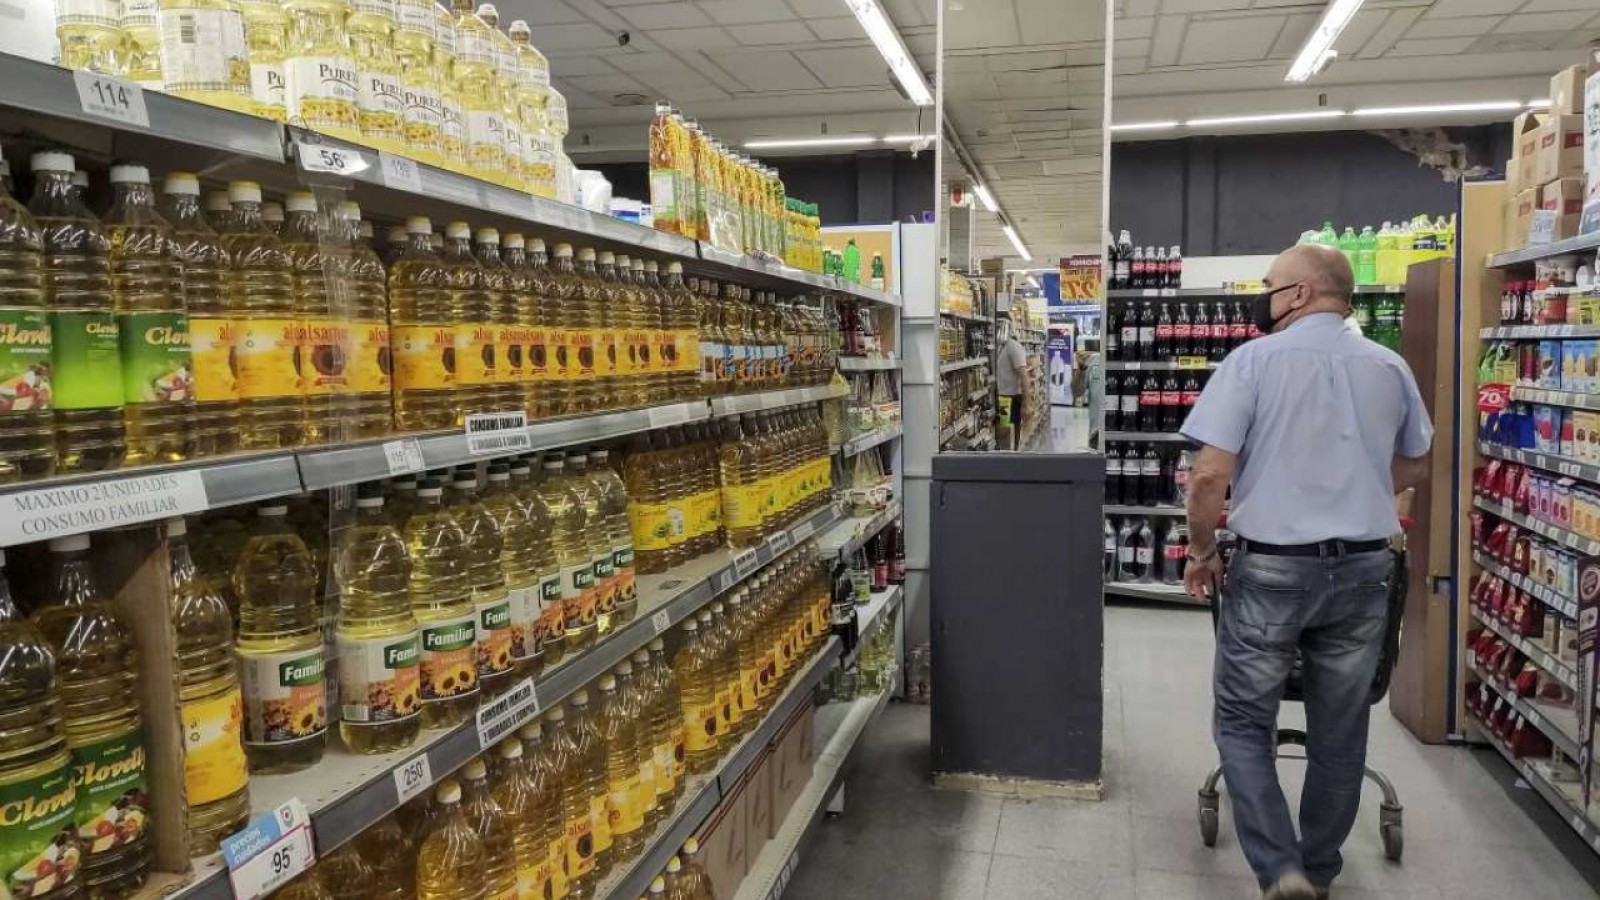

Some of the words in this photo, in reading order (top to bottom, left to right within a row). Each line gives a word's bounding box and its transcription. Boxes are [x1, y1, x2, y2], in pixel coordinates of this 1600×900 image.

[94, 80, 129, 109] 114
[320, 149, 345, 169] 56
[14, 487, 89, 512] MAXIMO
[22, 508, 106, 536] CONSUMO
[109, 496, 178, 520] FAMILIAR
[404, 762, 423, 786] 250
[273, 848, 291, 874] 95
